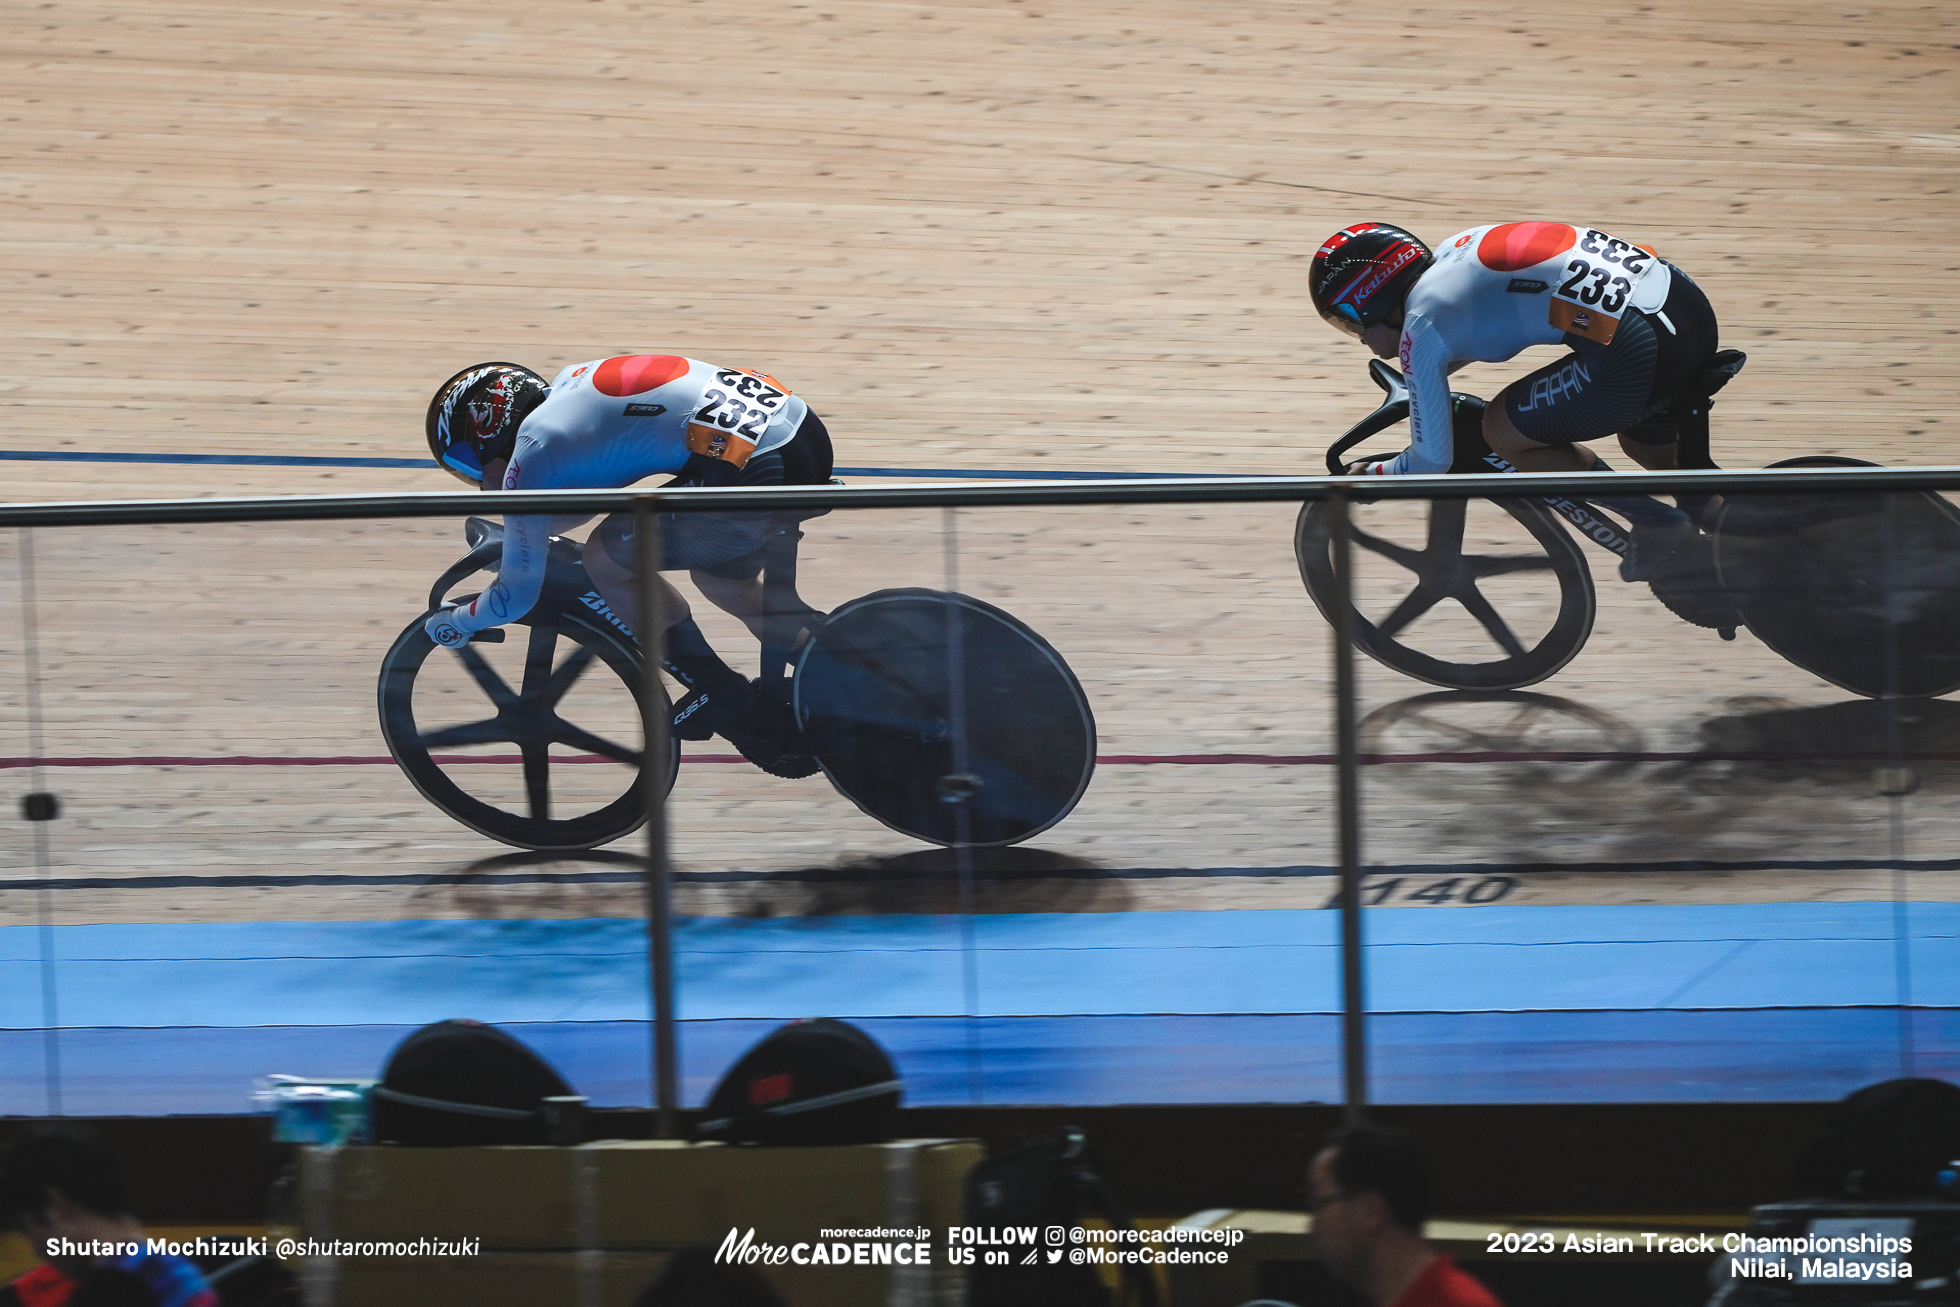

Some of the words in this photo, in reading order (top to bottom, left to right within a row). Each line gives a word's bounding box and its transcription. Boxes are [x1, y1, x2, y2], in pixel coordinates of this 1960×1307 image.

[1353, 247, 1417, 305] Kabuto
[1580, 229, 1651, 275] 233
[1557, 259, 1631, 313] 233
[716, 368, 784, 408] 232
[1518, 360, 1592, 412] JAPAN
[694, 388, 768, 441] 232
[674, 693, 709, 726] Q36.5
[1360, 877, 1521, 905] 140
